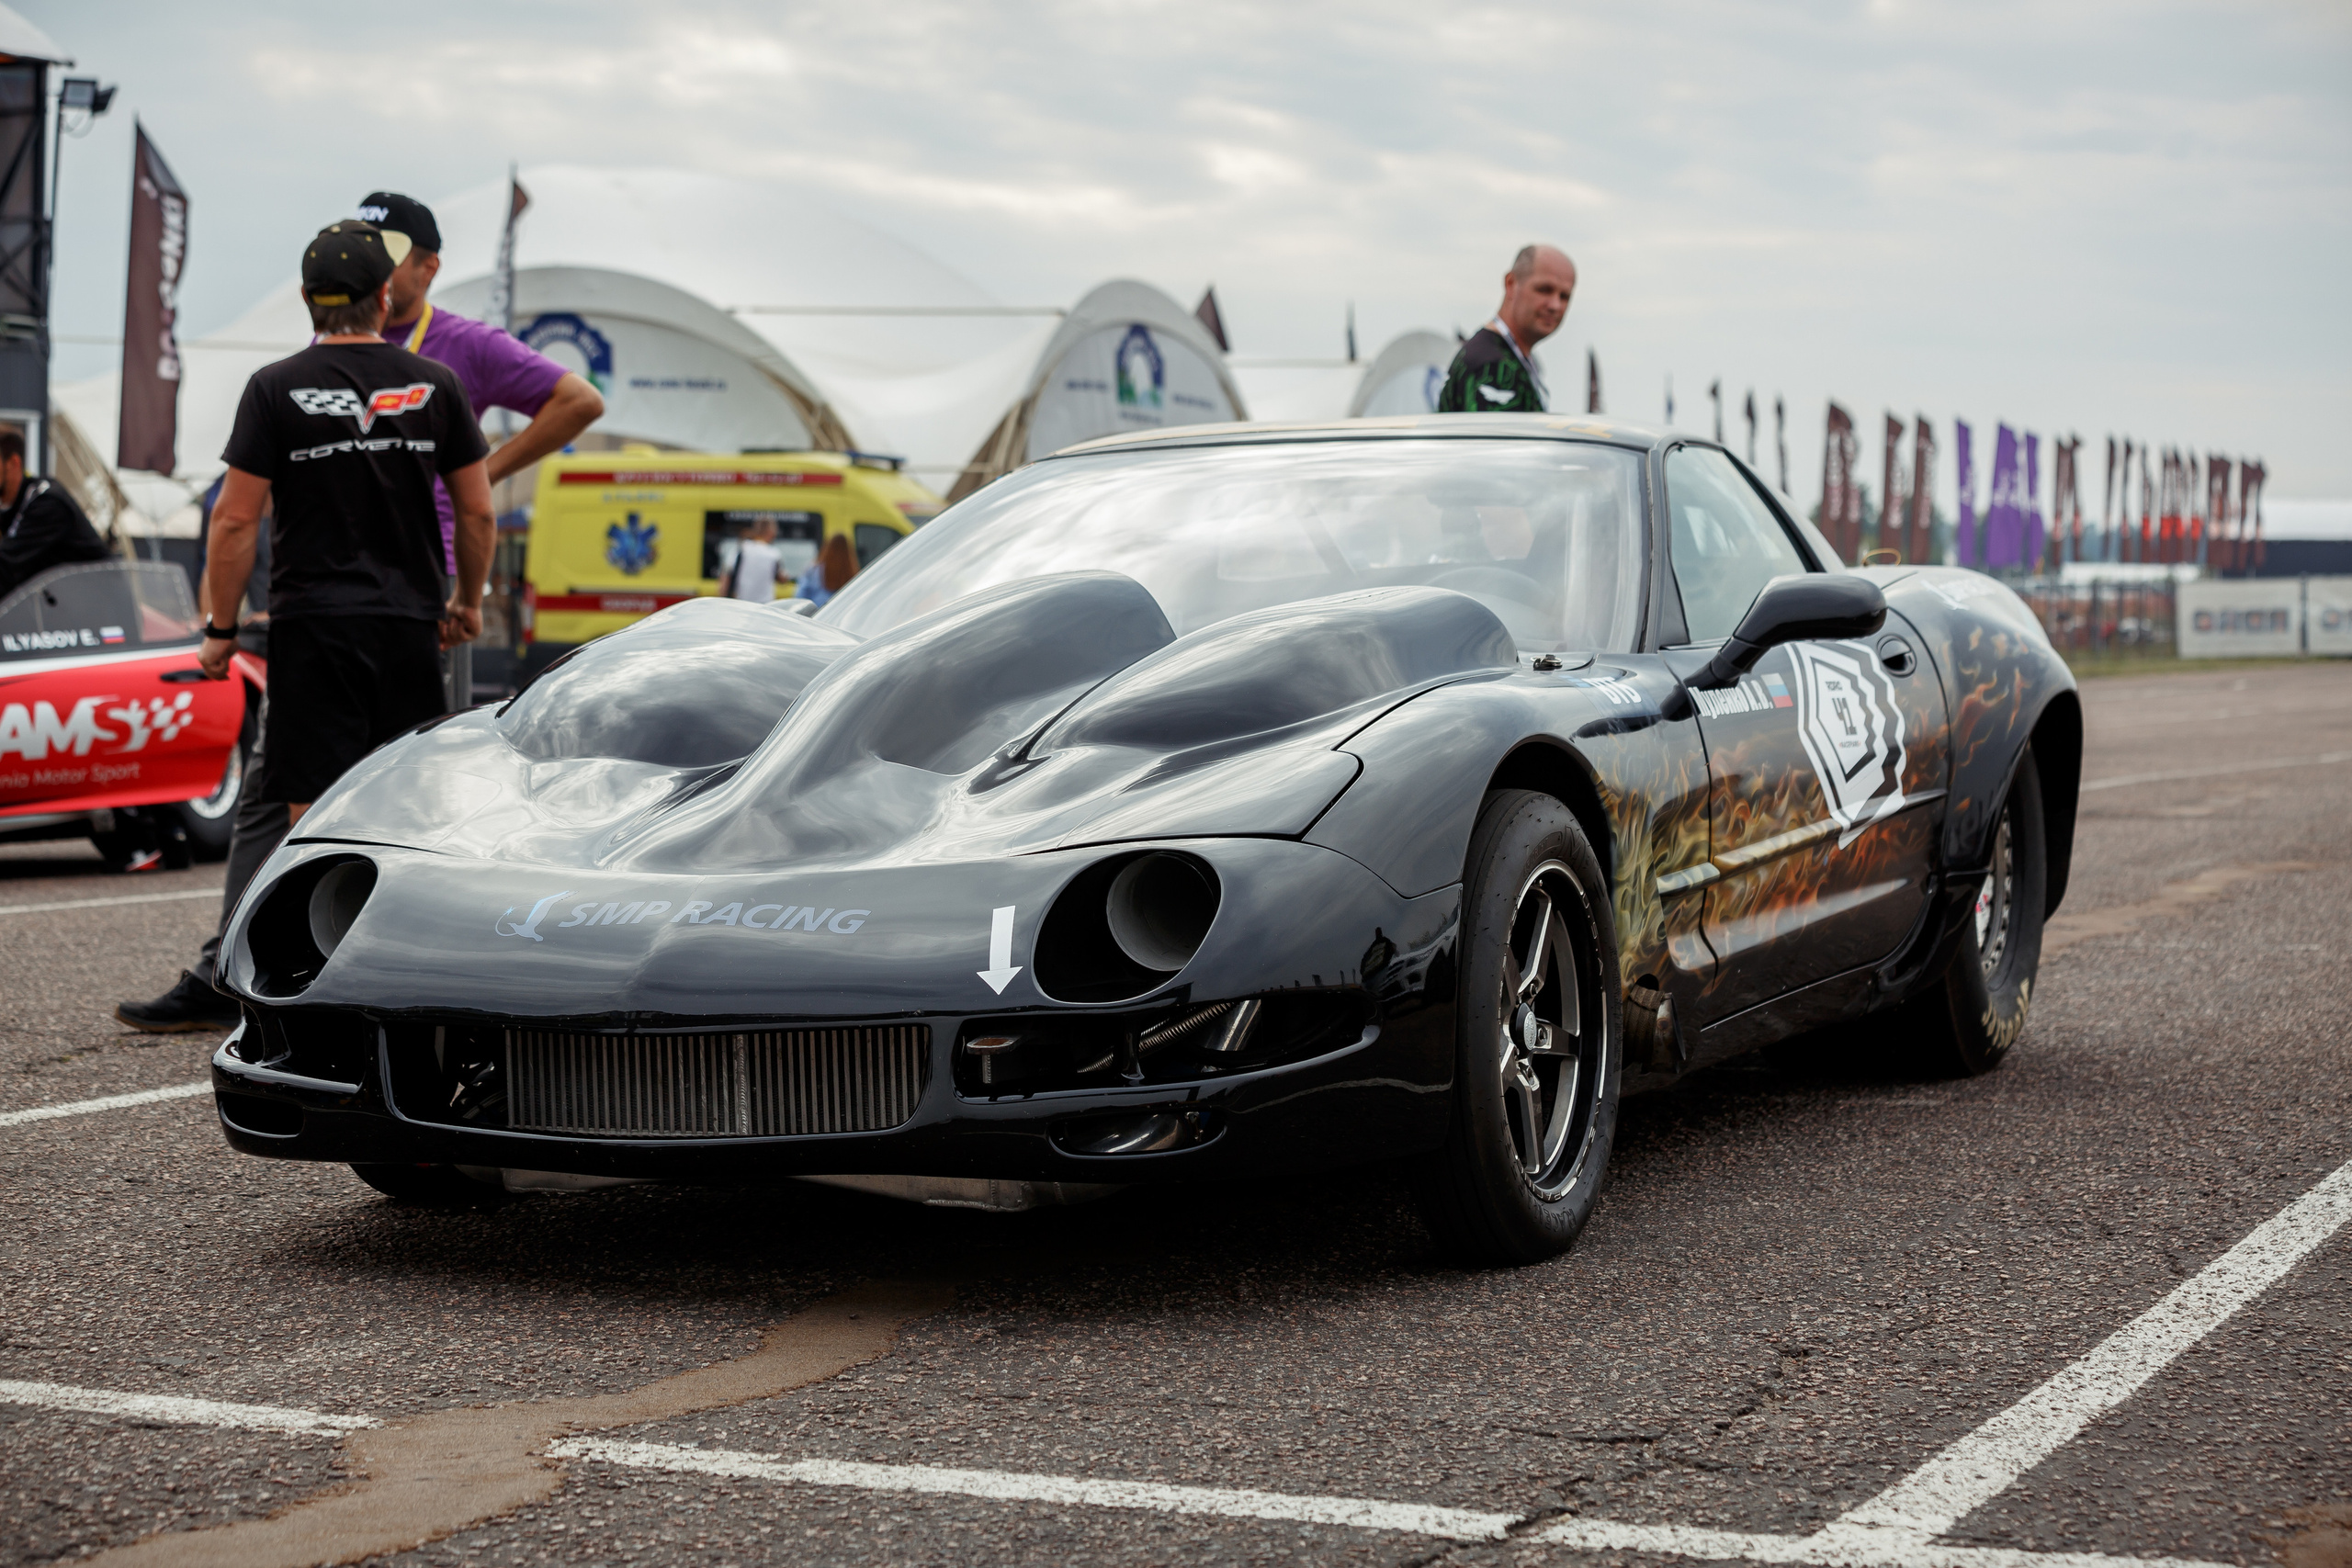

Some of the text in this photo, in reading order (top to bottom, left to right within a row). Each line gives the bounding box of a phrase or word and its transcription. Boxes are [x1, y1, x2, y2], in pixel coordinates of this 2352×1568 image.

[289, 437, 436, 462] CORVETTE
[2, 628, 100, 652] ILYASOV E.
[90, 761, 141, 787] Sport
[558, 899, 872, 935] SMP RACING
